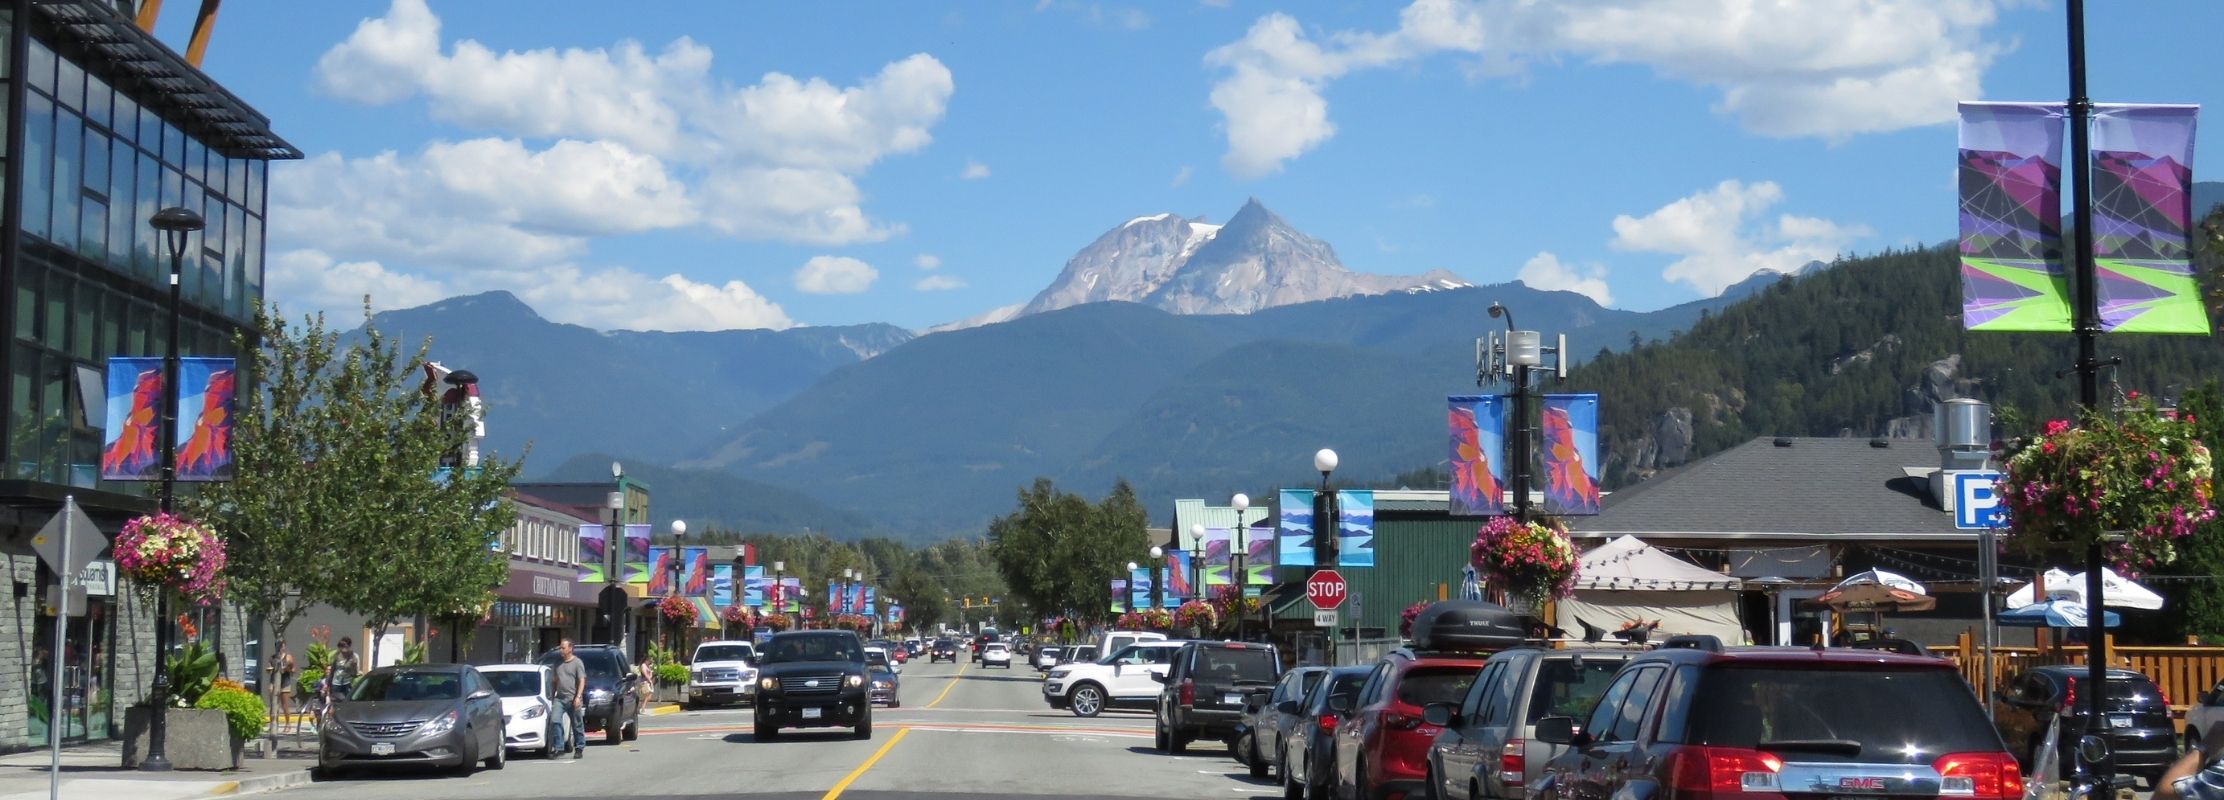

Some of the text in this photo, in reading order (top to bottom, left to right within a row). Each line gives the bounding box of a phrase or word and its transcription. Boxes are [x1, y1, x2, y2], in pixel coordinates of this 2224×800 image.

[1963, 478, 2000, 524] P
[1308, 581, 1345, 597] STOP
[1316, 614, 1336, 623] 4 WAY
[1839, 776, 1885, 789] GMC
